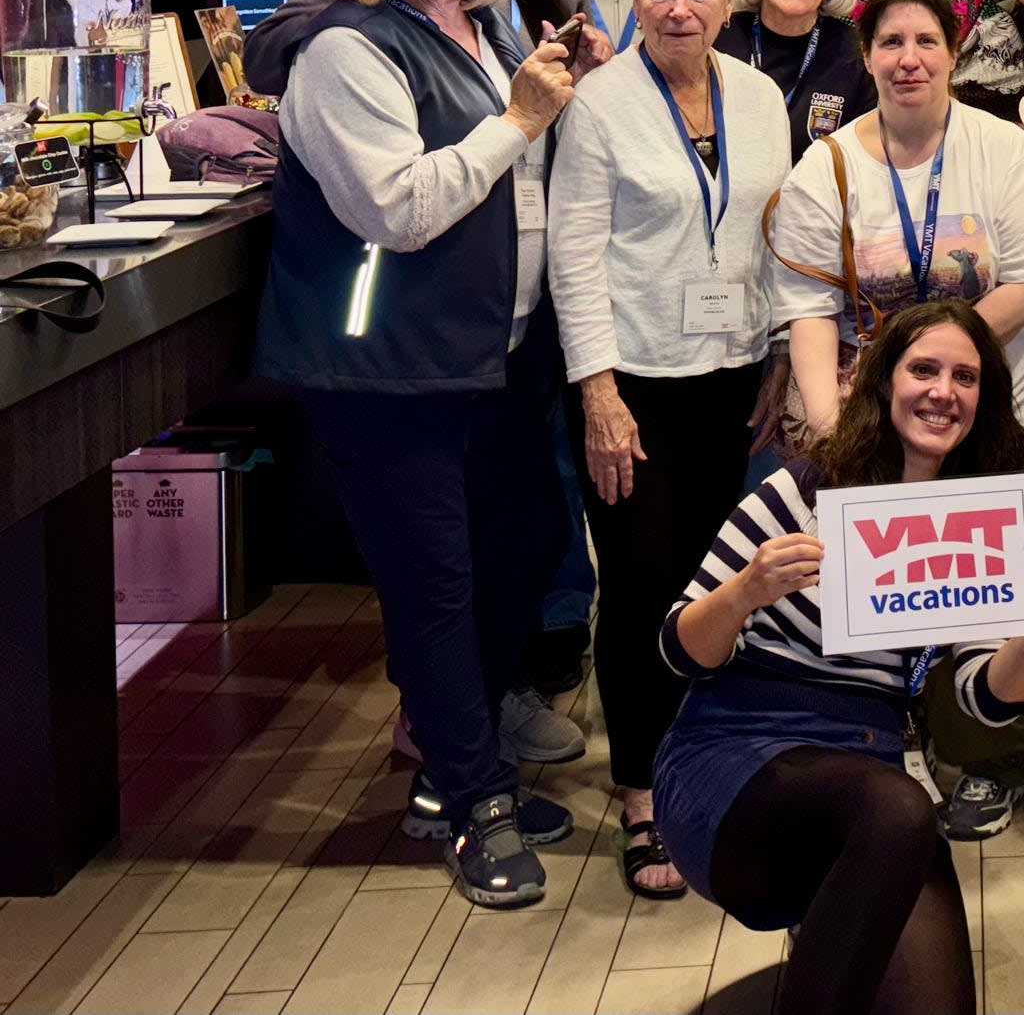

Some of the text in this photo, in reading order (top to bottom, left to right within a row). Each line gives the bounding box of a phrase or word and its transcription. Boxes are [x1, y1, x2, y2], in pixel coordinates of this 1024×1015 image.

[812, 92, 845, 104] OXFORD
[924, 223, 934, 243] YMT
[153, 488, 177, 497] ANY
[146, 498, 184, 508] OTHER
[147, 508, 184, 518] WASTE
[853, 507, 1018, 586] YMT
[870, 582, 1015, 614] vacations
